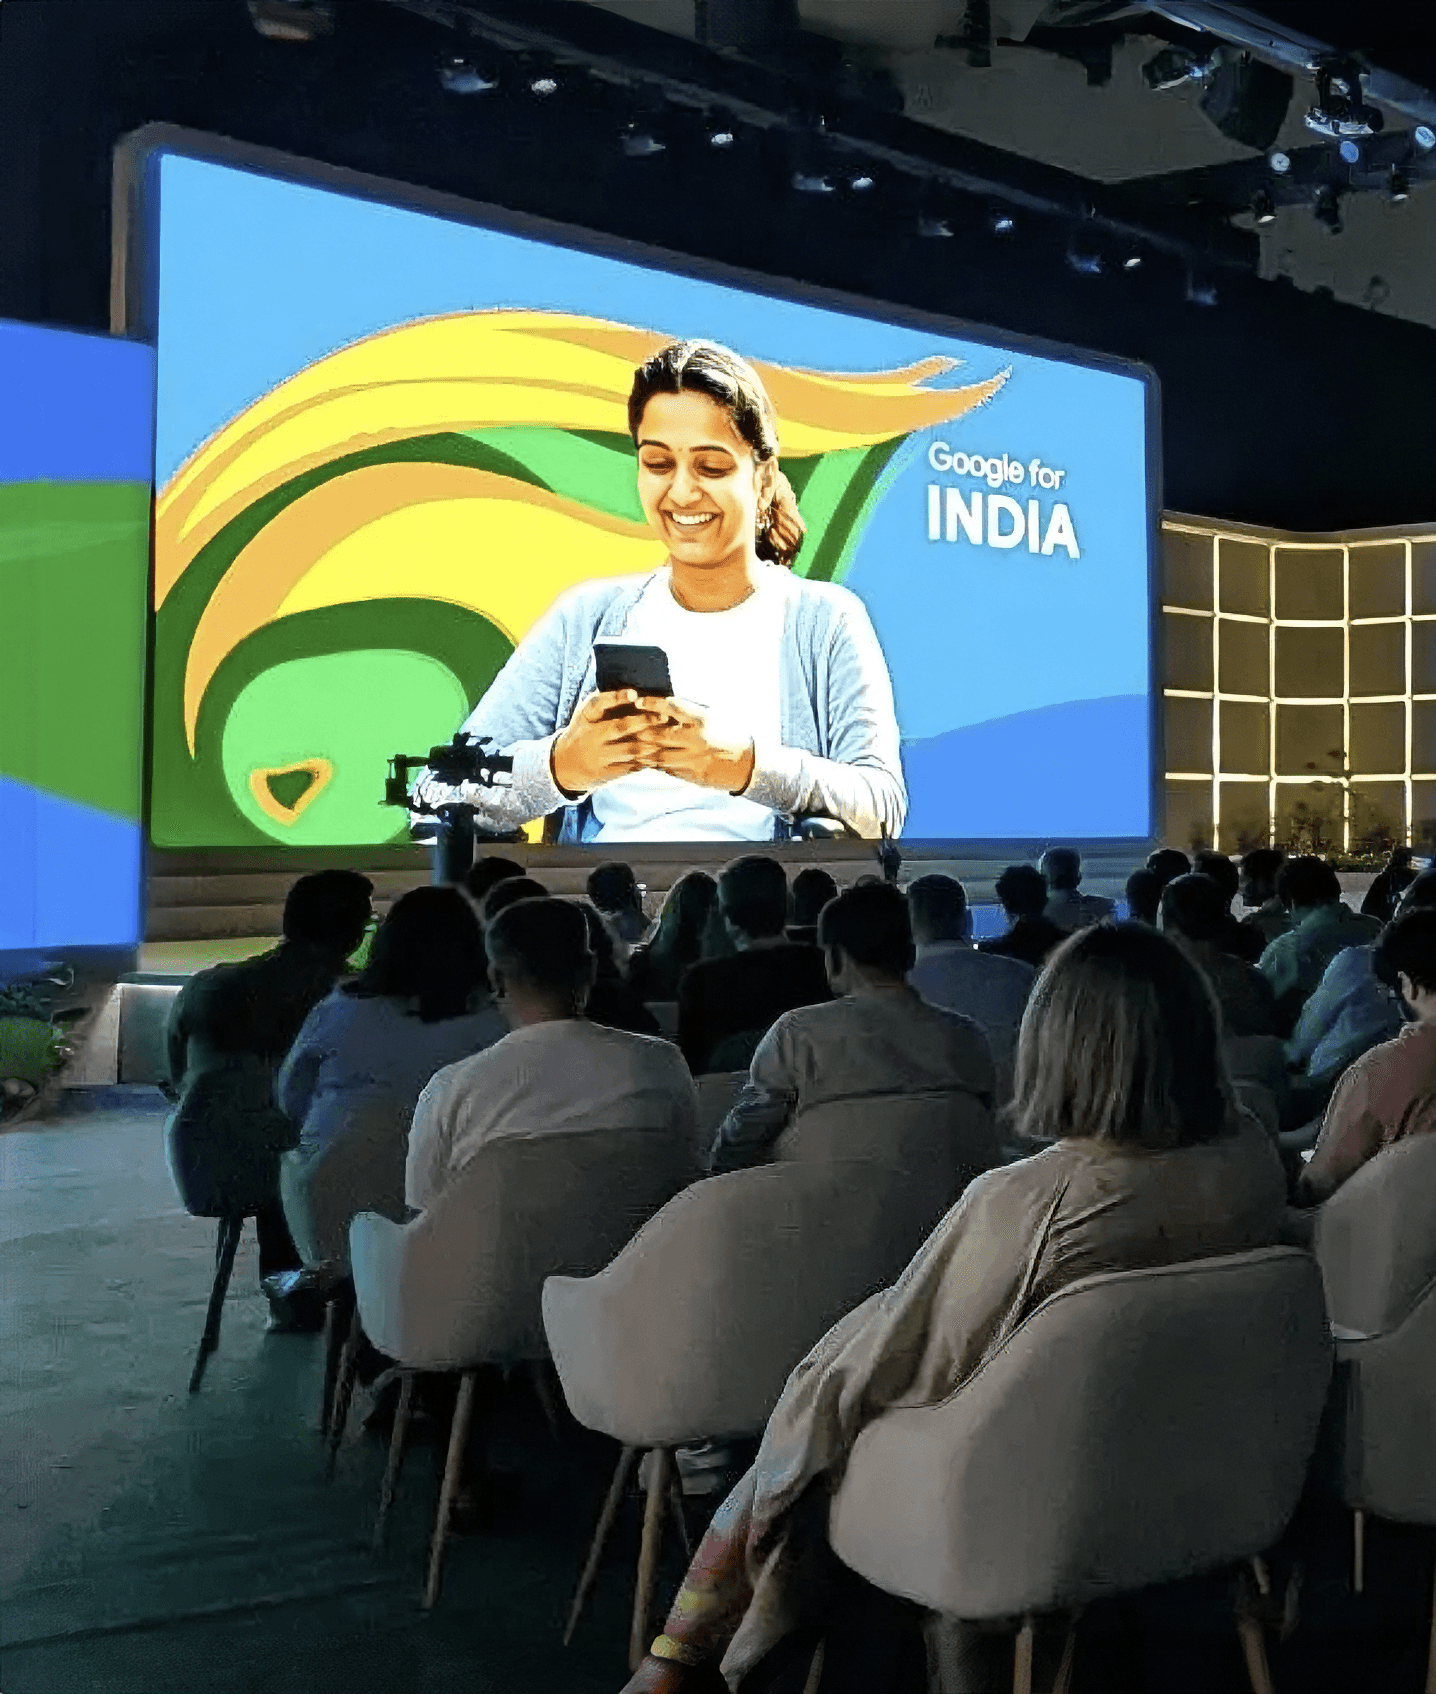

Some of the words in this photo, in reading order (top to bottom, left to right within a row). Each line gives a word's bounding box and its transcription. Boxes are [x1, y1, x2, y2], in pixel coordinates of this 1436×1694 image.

[928, 442, 1025, 488] Google
[1028, 459, 1065, 490] for
[928, 484, 1081, 559] INDIA
